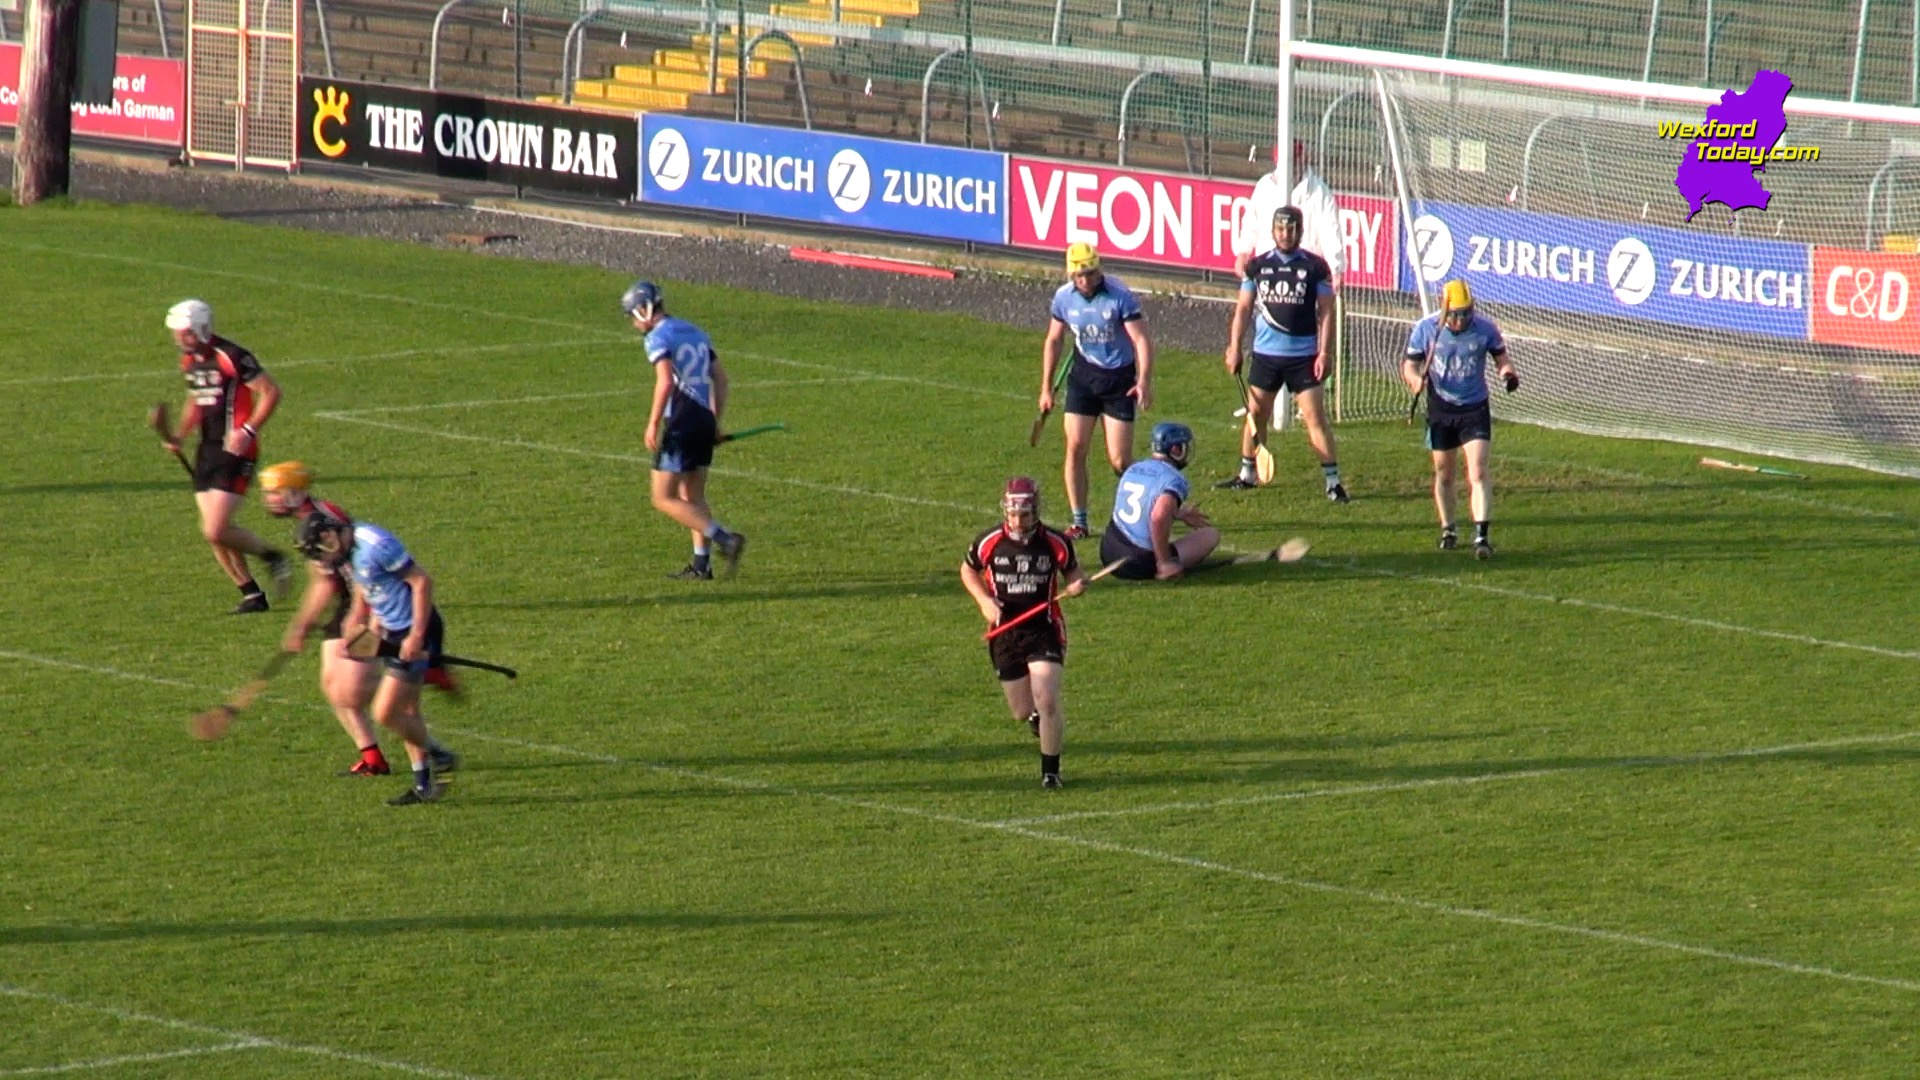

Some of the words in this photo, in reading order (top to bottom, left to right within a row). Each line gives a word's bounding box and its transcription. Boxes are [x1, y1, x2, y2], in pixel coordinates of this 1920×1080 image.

[124, 99, 175, 121] Garman
[132, 74, 147, 92] of
[366, 104, 424, 153] THE
[434, 112, 544, 169] CROWN
[551, 128, 618, 180] BAR
[702, 148, 814, 193] ZURICH
[882, 169, 997, 215] ZURICH
[1019, 165, 1193, 259] VEON
[1467, 236, 1595, 284] ZURICH
[1670, 259, 1802, 309] ZURICH
[1826, 265, 1909, 322] C&D
[676, 342, 713, 385] 22
[1117, 481, 1145, 525] 3
